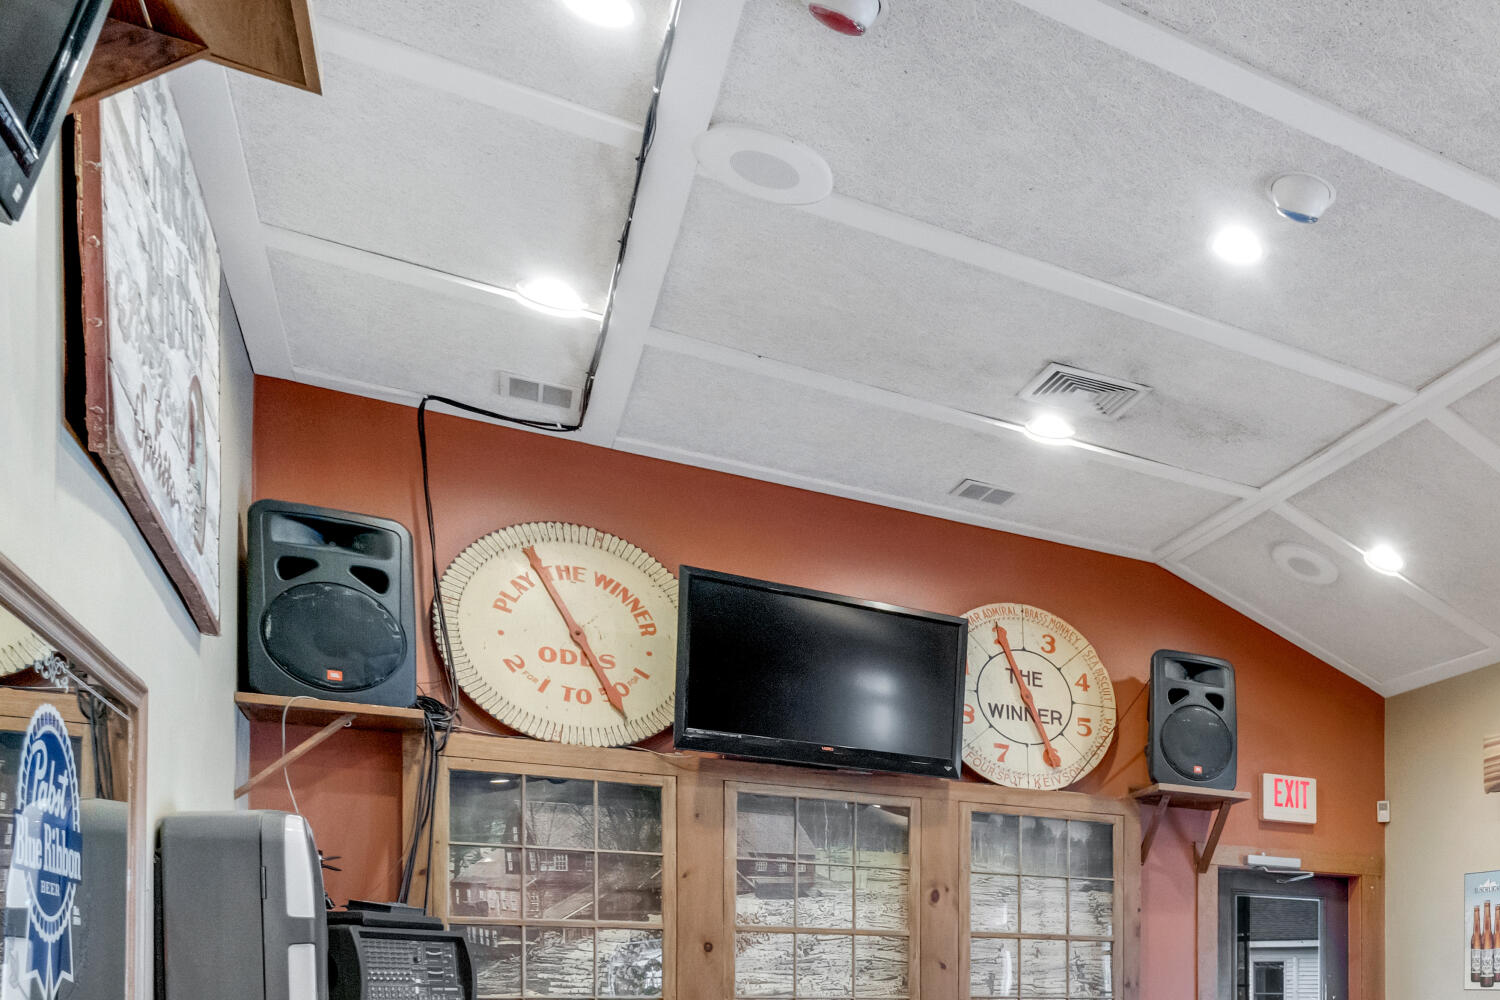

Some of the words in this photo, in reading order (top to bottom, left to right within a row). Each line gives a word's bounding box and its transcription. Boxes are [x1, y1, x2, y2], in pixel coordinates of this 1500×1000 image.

[492, 571, 536, 614] PLAY
[541, 565, 587, 583] THE
[594, 571, 657, 637] WINNER
[967, 612, 981, 626] AR
[1041, 634, 1056, 654] 3
[502, 654, 525, 673] 2
[561, 685, 592, 705] TO
[1005, 667, 1043, 688] THE
[1074, 672, 1090, 693] 4
[988, 702, 1062, 726] WINNER
[1077, 717, 1093, 737] 5
[993, 743, 1010, 762] 7
[31, 739, 69, 819] Pabst
[1274, 778, 1310, 809] EXIT
[15, 814, 42, 870] Blue
[44, 823, 82, 881] Ribbon
[40, 880, 60, 897] BEER
